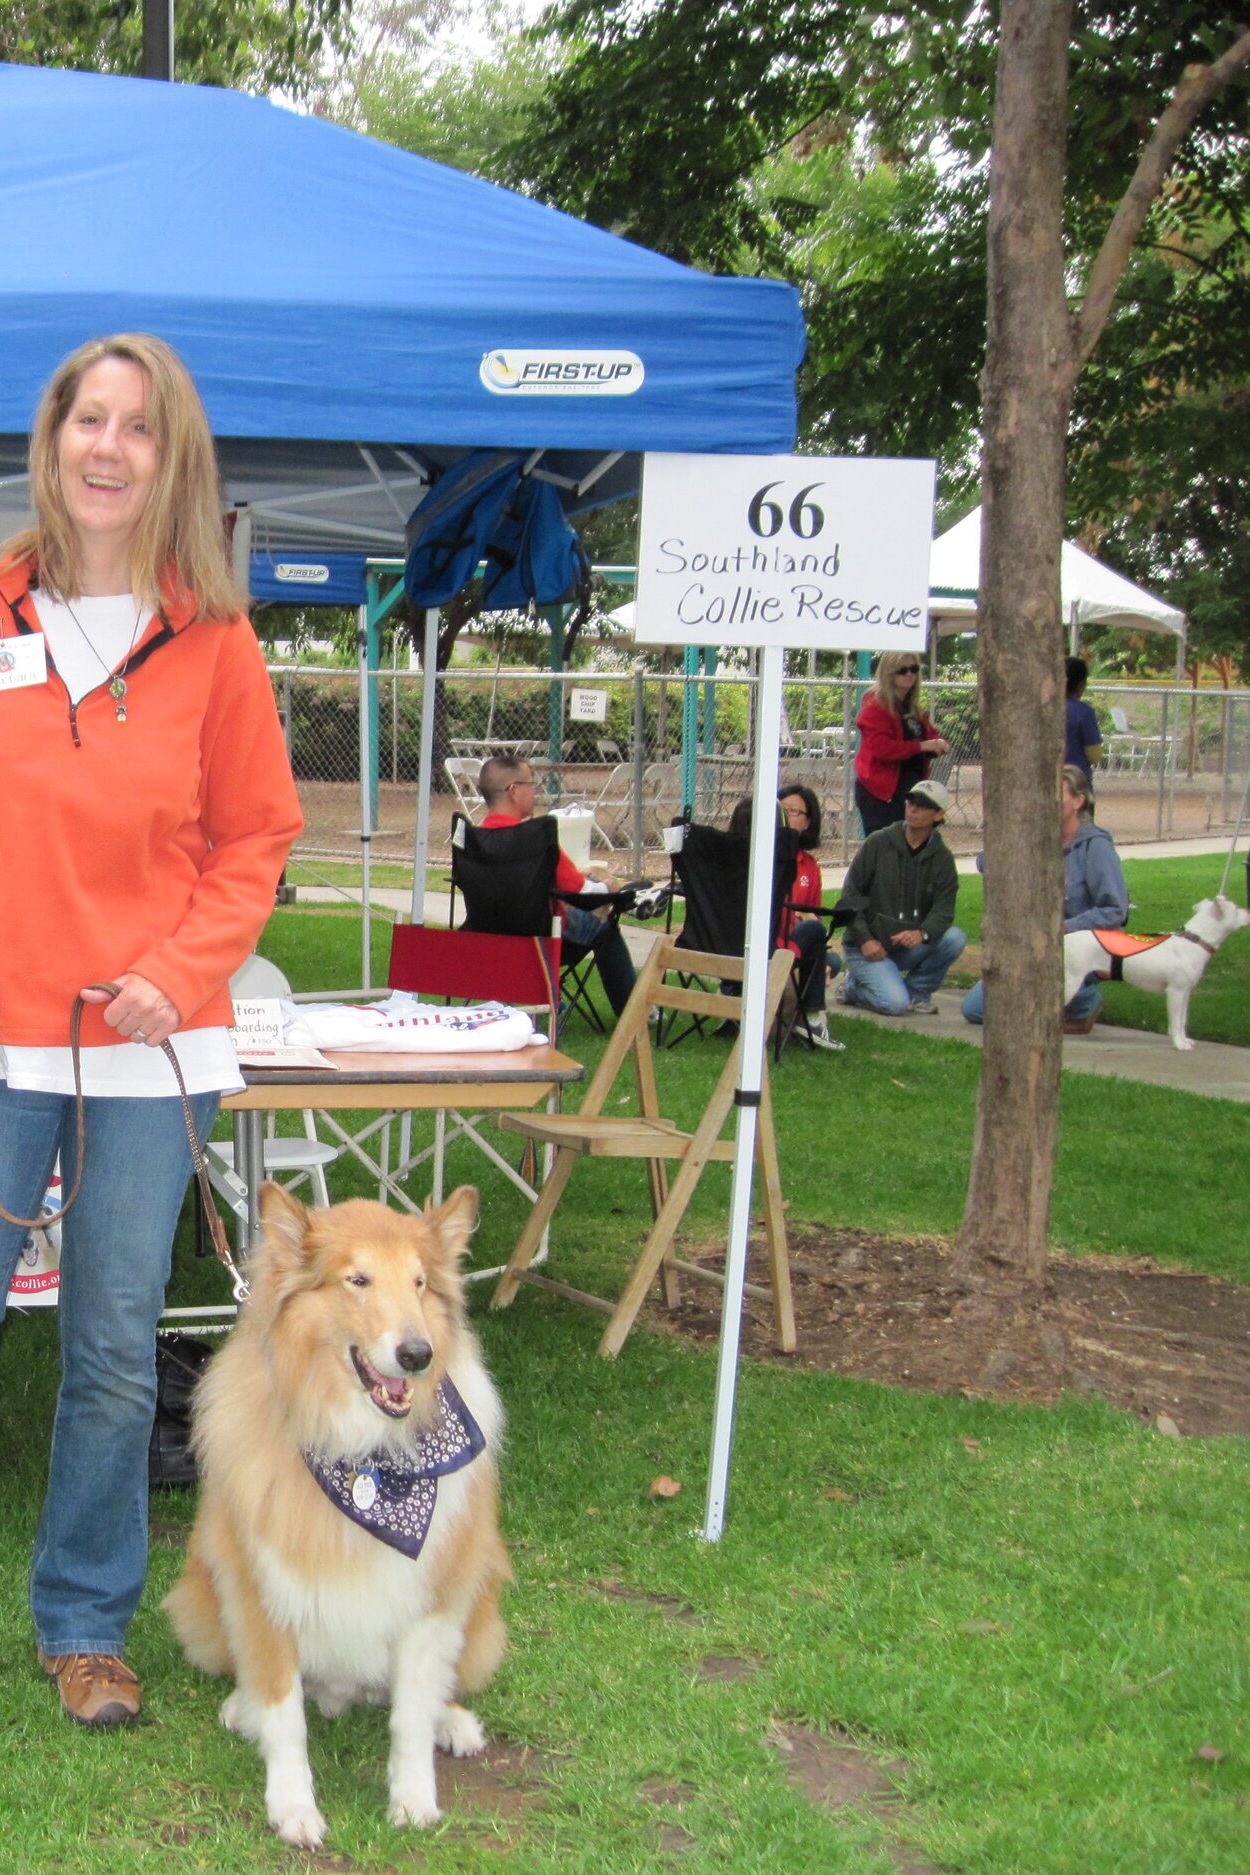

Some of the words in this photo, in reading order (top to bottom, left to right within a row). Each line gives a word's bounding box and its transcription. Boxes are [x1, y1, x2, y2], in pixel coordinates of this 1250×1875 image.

[521, 362, 633, 380] FIRST-UP
[747, 480, 827, 539] 66
[655, 538, 840, 577] Southland
[677, 582, 784, 625] Collie
[790, 584, 922, 629] Rescue
[232, 1004, 266, 1016] tion
